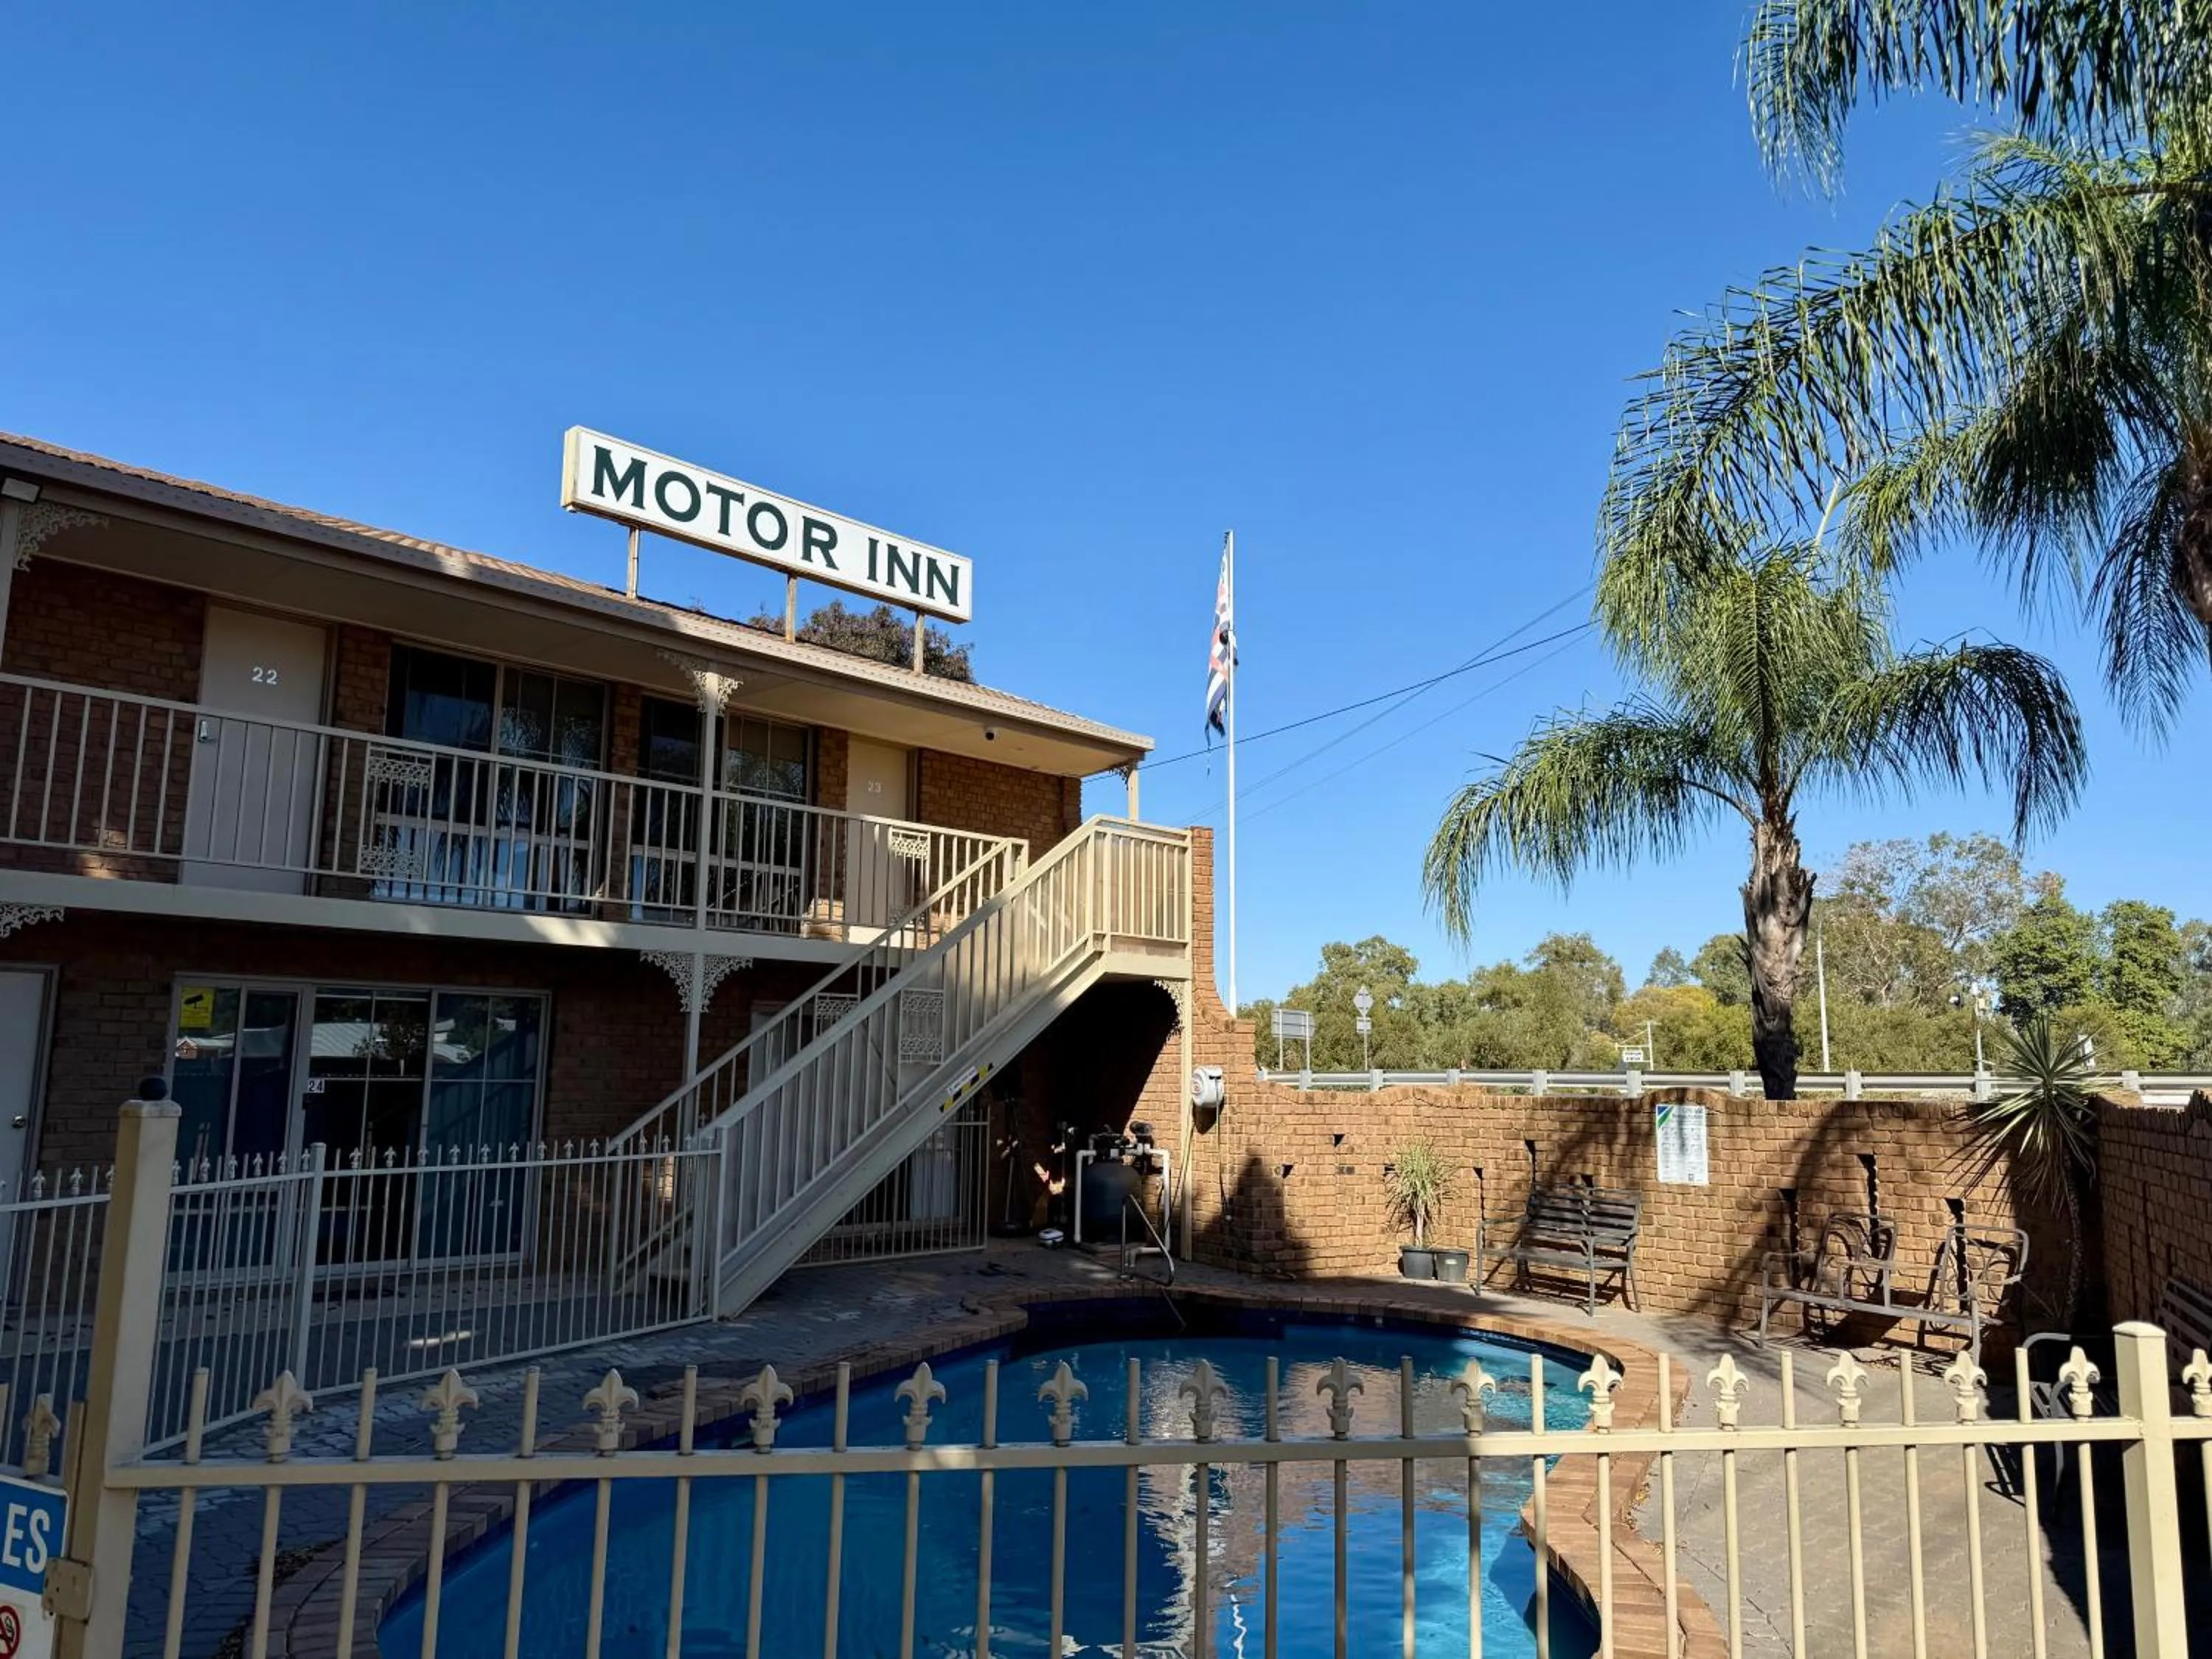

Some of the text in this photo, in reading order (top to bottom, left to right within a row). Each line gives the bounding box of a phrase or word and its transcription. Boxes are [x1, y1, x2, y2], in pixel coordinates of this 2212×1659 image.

[591, 445, 960, 607] MOTOR INN
[251, 666, 277, 685] 22
[308, 1079, 323, 1092] 24
